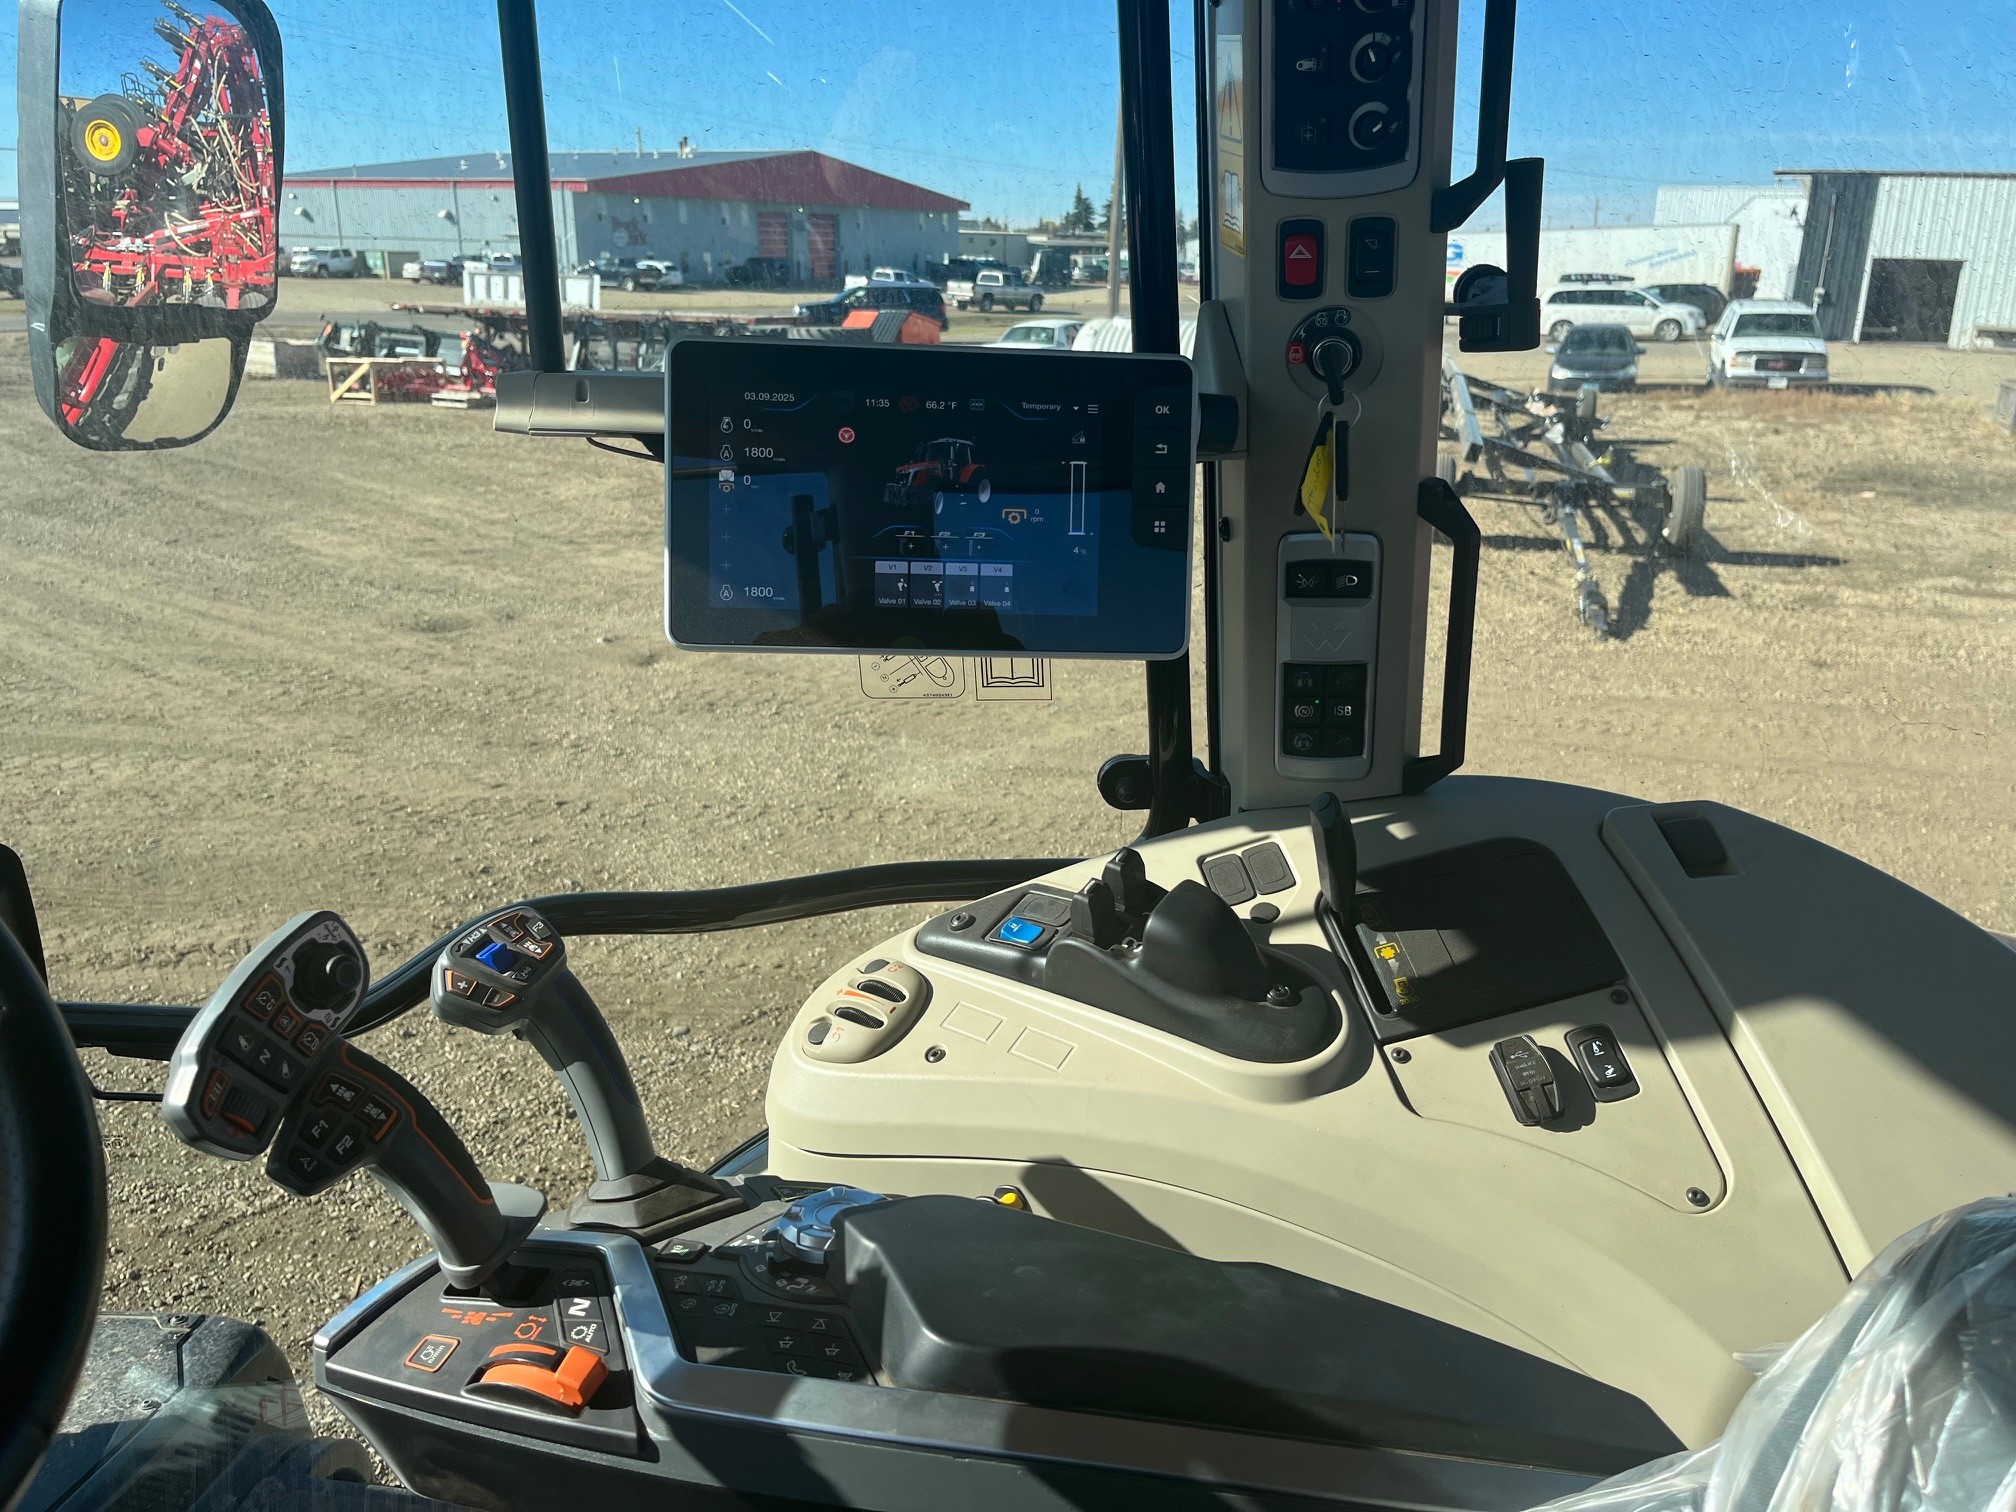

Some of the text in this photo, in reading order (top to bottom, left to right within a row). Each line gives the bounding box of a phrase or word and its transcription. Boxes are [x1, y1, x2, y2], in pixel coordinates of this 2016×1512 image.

[744, 392, 795, 402] 03.09.2025
[865, 398, 890, 408] 11:35
[925, 400, 946, 410] 66.2
[1021, 402, 1062, 412] Temporary
[1155, 405, 1171, 415] OK
[743, 418, 752, 430] 0
[744, 447, 774, 458] 1800
[743, 475, 752, 486] 0
[1073, 546, 1080, 555] 4
[744, 586, 774, 598] 1800
[879, 597, 896, 605] Valve
[1333, 705, 1352, 717] ISB
[532, 921, 544, 932] F3
[468, 931, 481, 942] H3
[887, 963, 904, 974] C2
[832, 1026, 845, 1042] C1
[311, 1119, 329, 1139] F1
[335, 1134, 354, 1155] F2
[568, 1297, 591, 1317] N
[585, 1323, 597, 1343] AUTO
